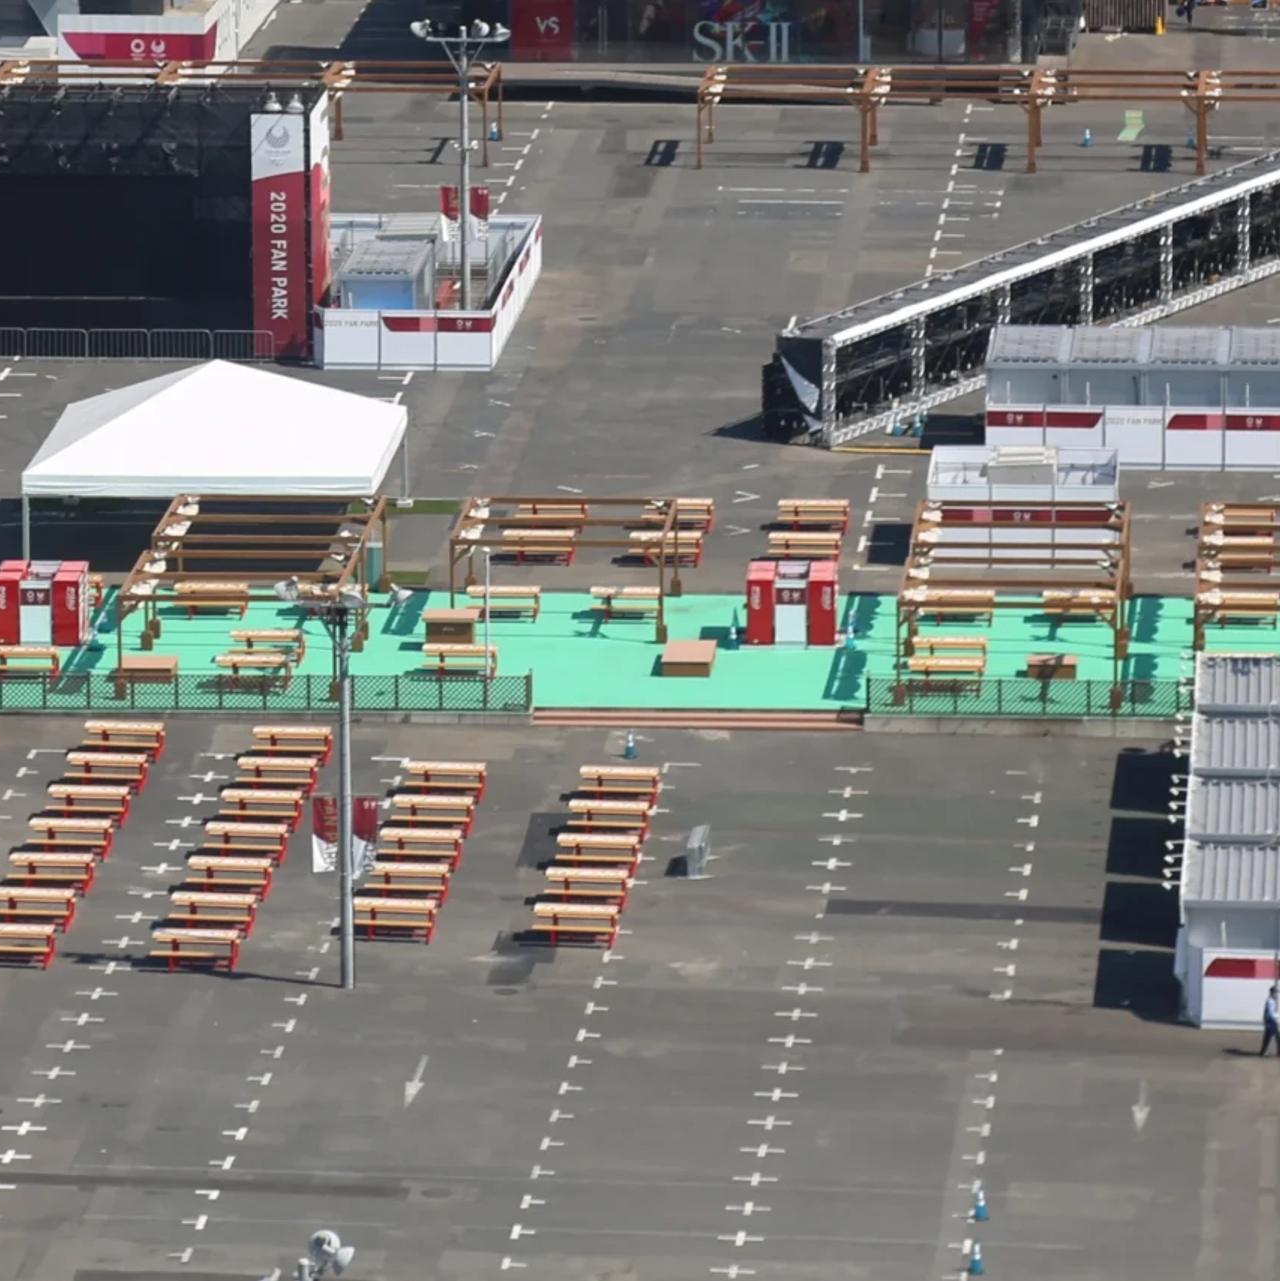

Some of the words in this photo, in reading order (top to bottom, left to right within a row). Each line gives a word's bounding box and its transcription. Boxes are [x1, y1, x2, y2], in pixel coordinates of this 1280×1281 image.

[692, 20, 792, 63] SK-II
[270, 191, 287, 234] 2020
[270, 239, 287, 271] FAN
[271, 277, 288, 320] PARK
